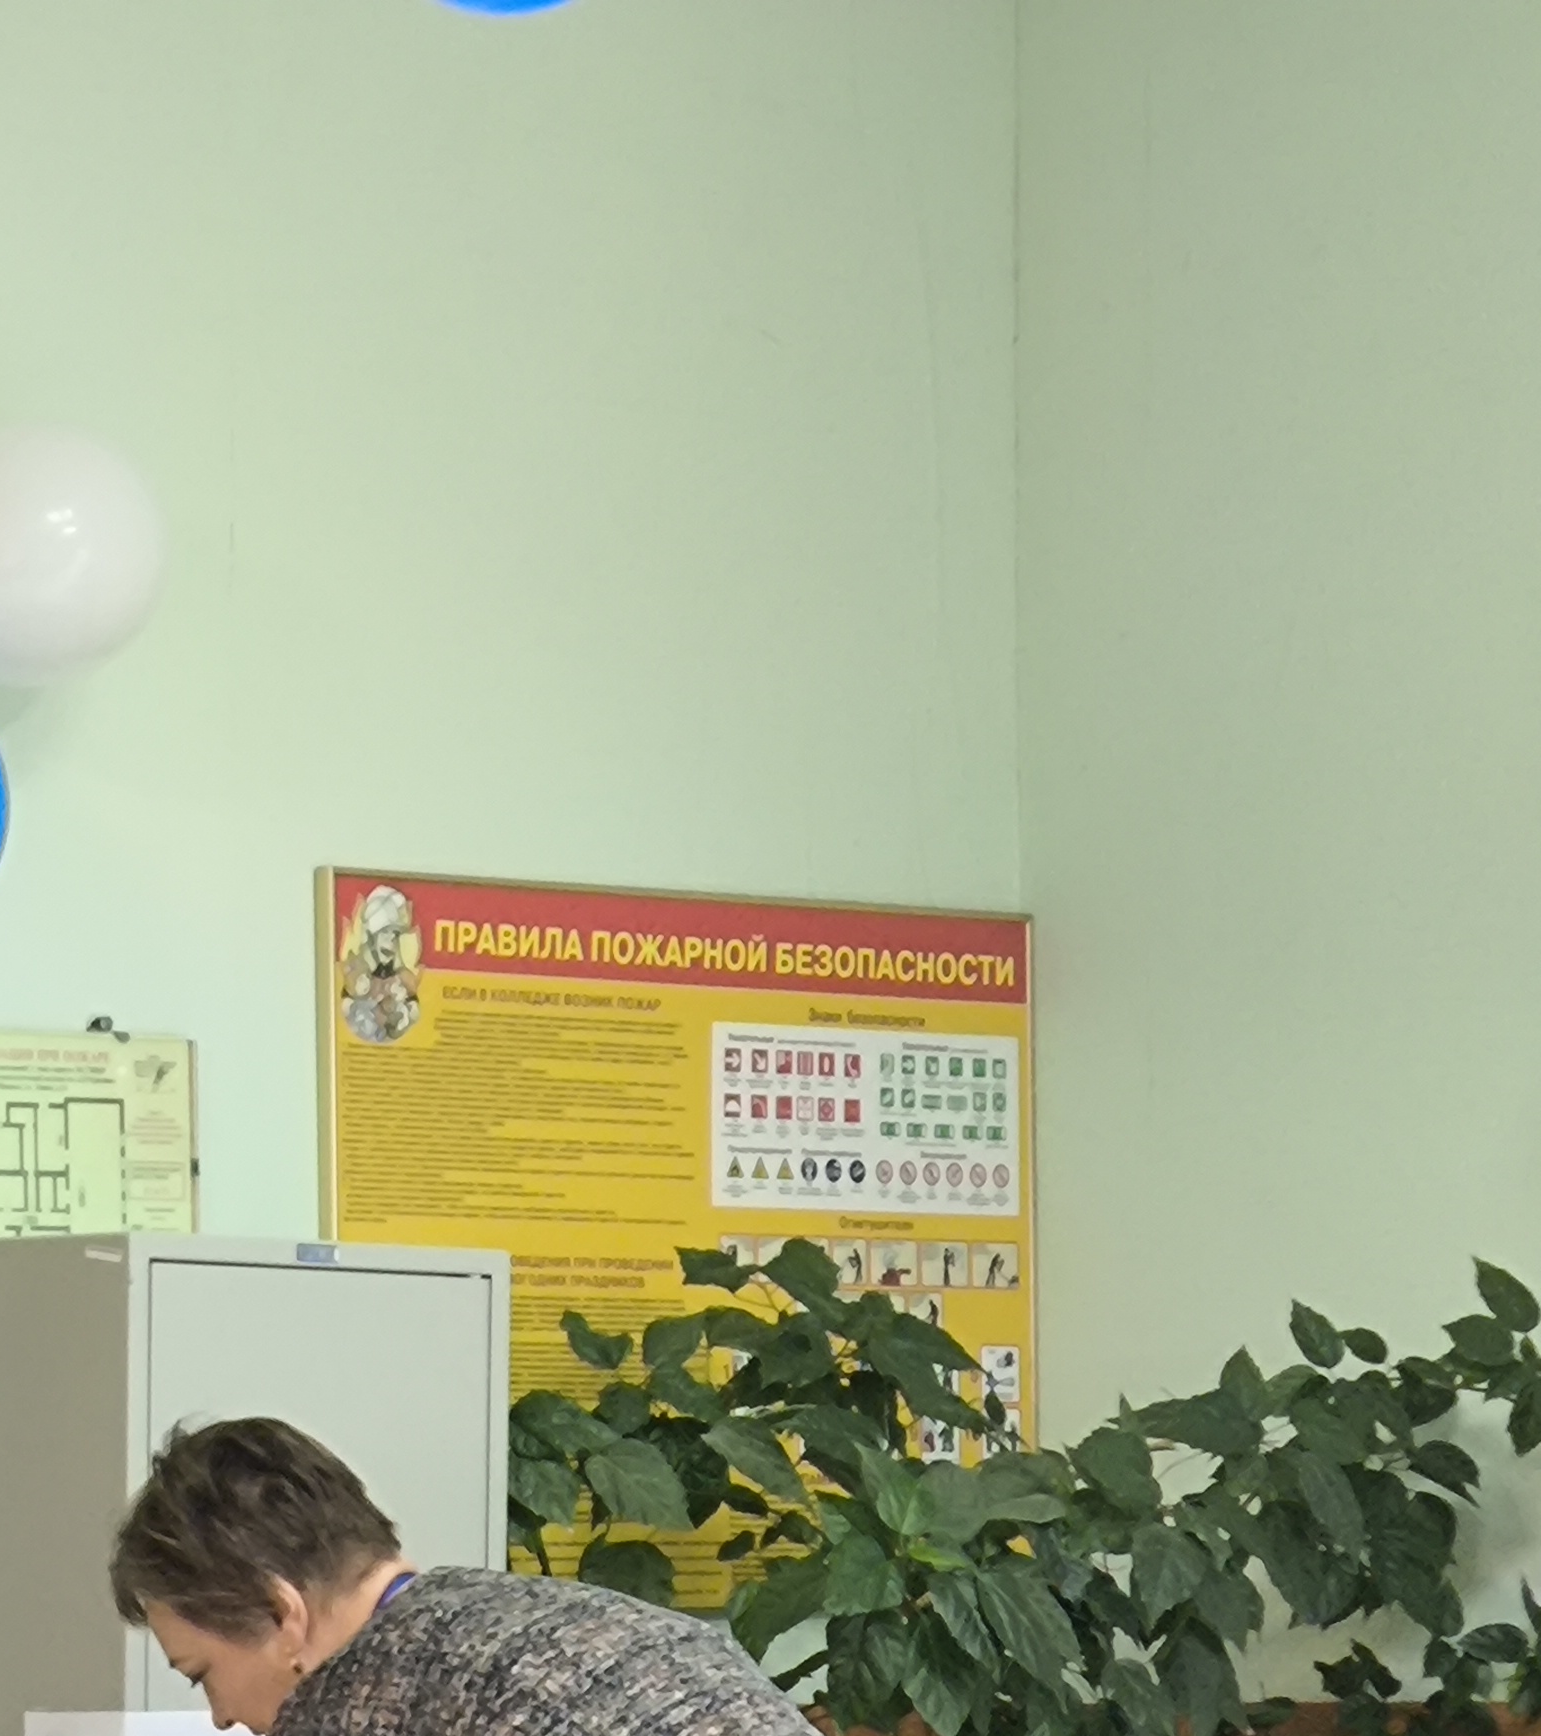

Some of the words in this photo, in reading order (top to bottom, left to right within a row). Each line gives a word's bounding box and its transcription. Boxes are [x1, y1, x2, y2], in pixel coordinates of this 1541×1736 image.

[434, 919, 585, 962] ПРАВИЛА
[590, 930, 768, 974] ПОЖАРНОЙ
[774, 941, 1016, 988] БЕЗОПАСНОСТИ
